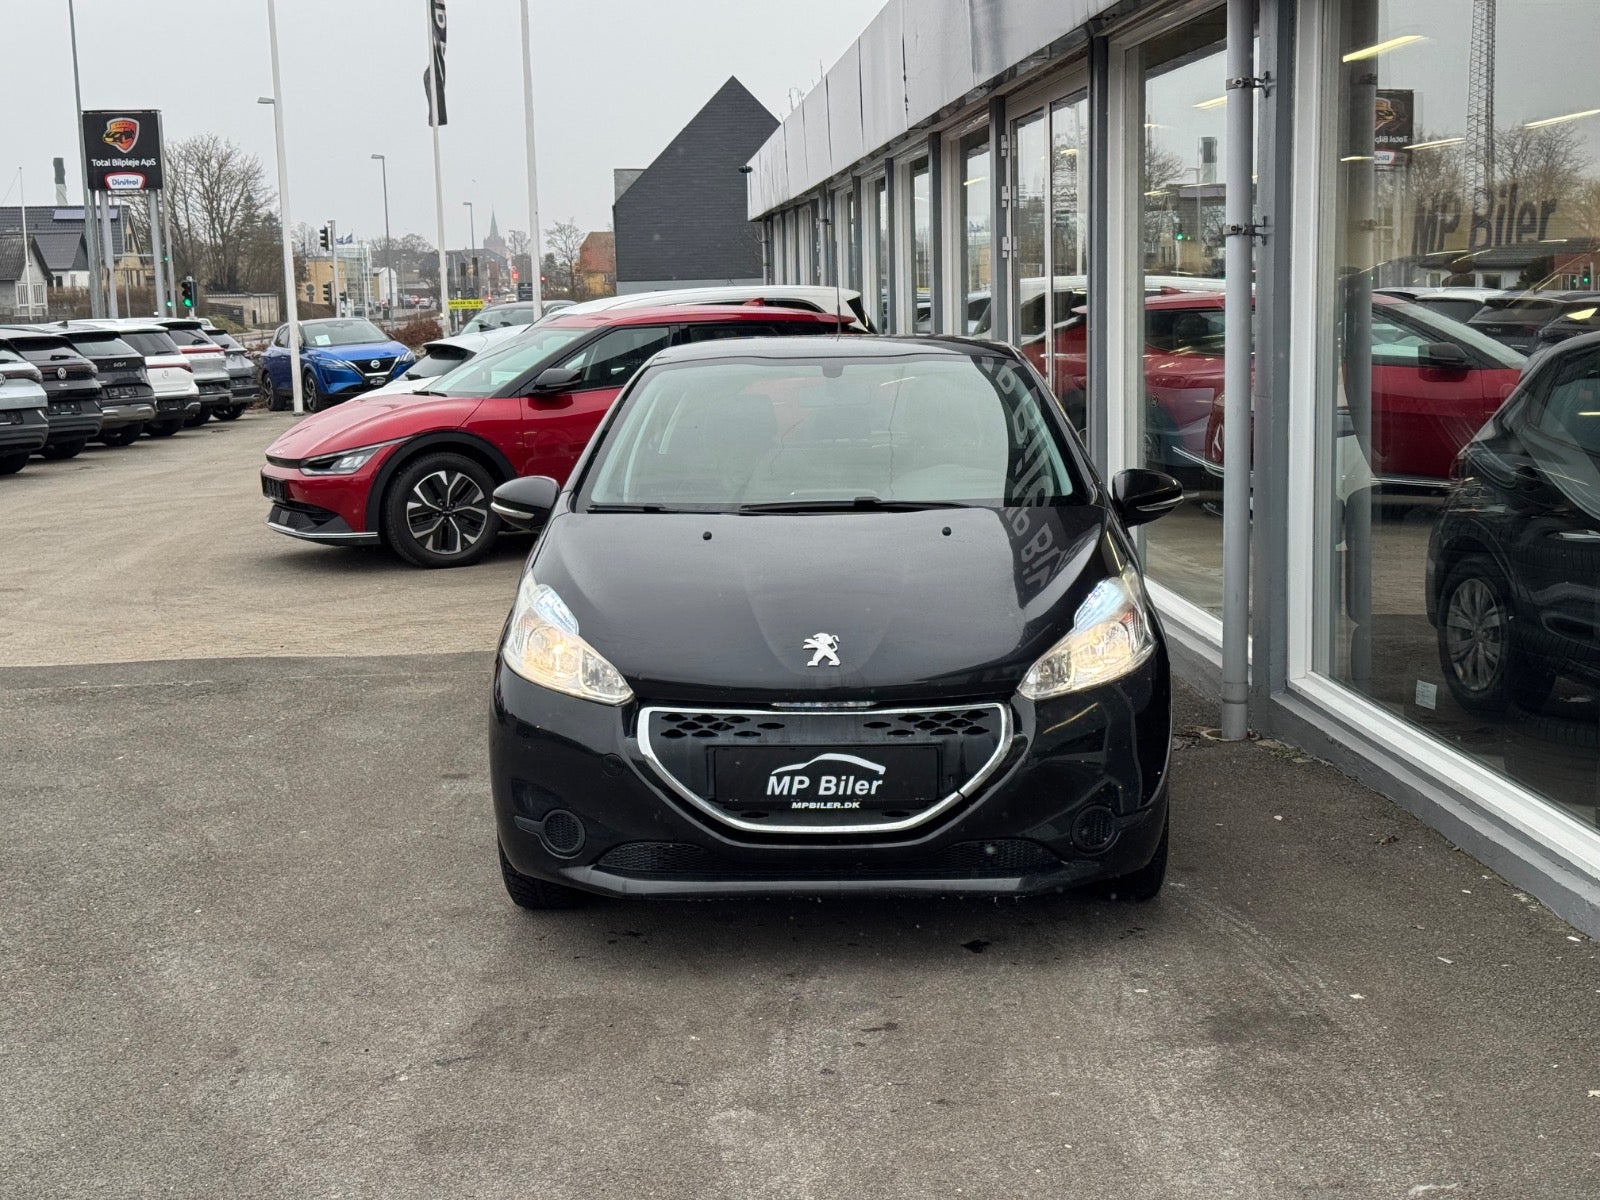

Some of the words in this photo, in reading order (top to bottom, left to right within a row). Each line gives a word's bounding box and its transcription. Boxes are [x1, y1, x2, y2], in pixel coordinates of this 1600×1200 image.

[91, 159, 111, 167] Total
[112, 158, 140, 168] Bilpleje
[140, 158, 156, 167] ApS
[1411, 192, 1462, 256] MP
[1468, 183, 1558, 252] Biler
[766, 775, 810, 796] MP
[818, 775, 883, 796] Biler
[791, 801, 861, 809] MPBILER.DK
